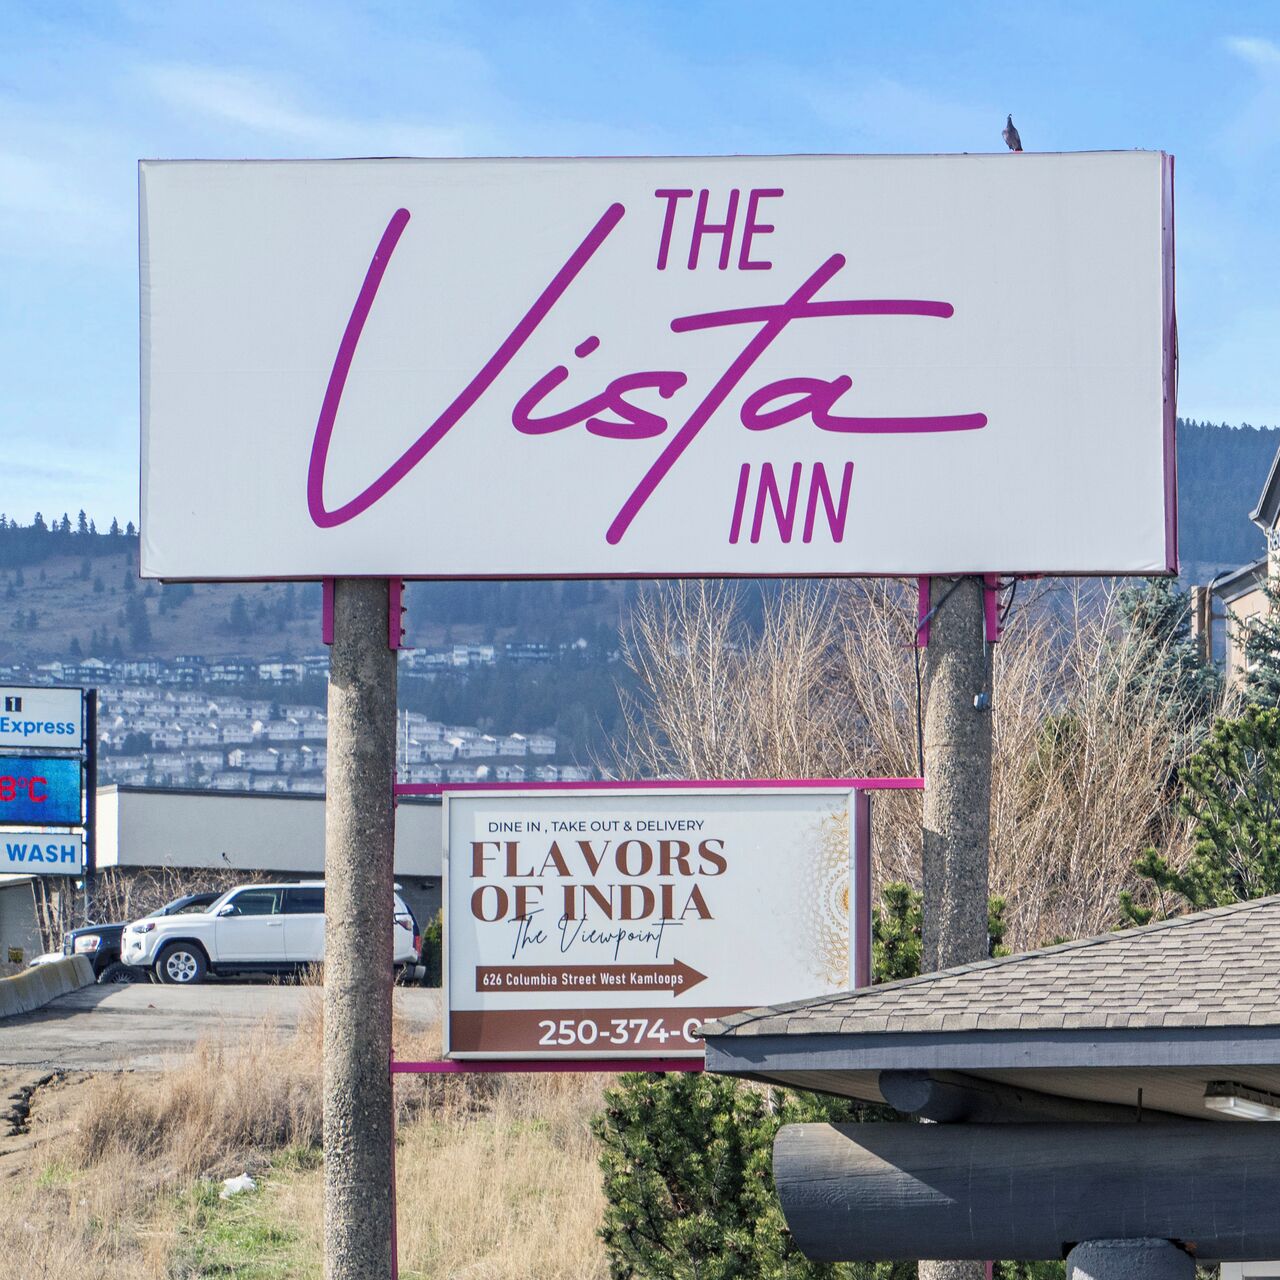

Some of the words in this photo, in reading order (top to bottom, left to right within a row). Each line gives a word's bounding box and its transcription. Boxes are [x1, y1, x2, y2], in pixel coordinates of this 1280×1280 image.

[655, 188, 784, 271] THE
[307, 202, 988, 546] Vista
[728, 461, 854, 545] INN
[0, 717, 75, 737] Express
[488, 821, 522, 833] DINE
[526, 821, 541, 832] IN
[552, 821, 586, 832] TAKE
[590, 821, 620, 832] OUT
[623, 821, 633, 832] &
[636, 820, 704, 832] DELIVERY
[6, 843, 76, 863] WASH
[469, 838, 728, 878] FLAVORS
[470, 884, 544, 922] OF
[561, 883, 715, 921] INDIA
[508, 908, 547, 960] The
[557, 912, 683, 962] Viewpoint
[483, 973, 502, 986] 626
[506, 973, 557, 985] Columbia
[561, 973, 597, 985] Street
[600, 972, 626, 985] West
[630, 971, 684, 987] Kamloops
